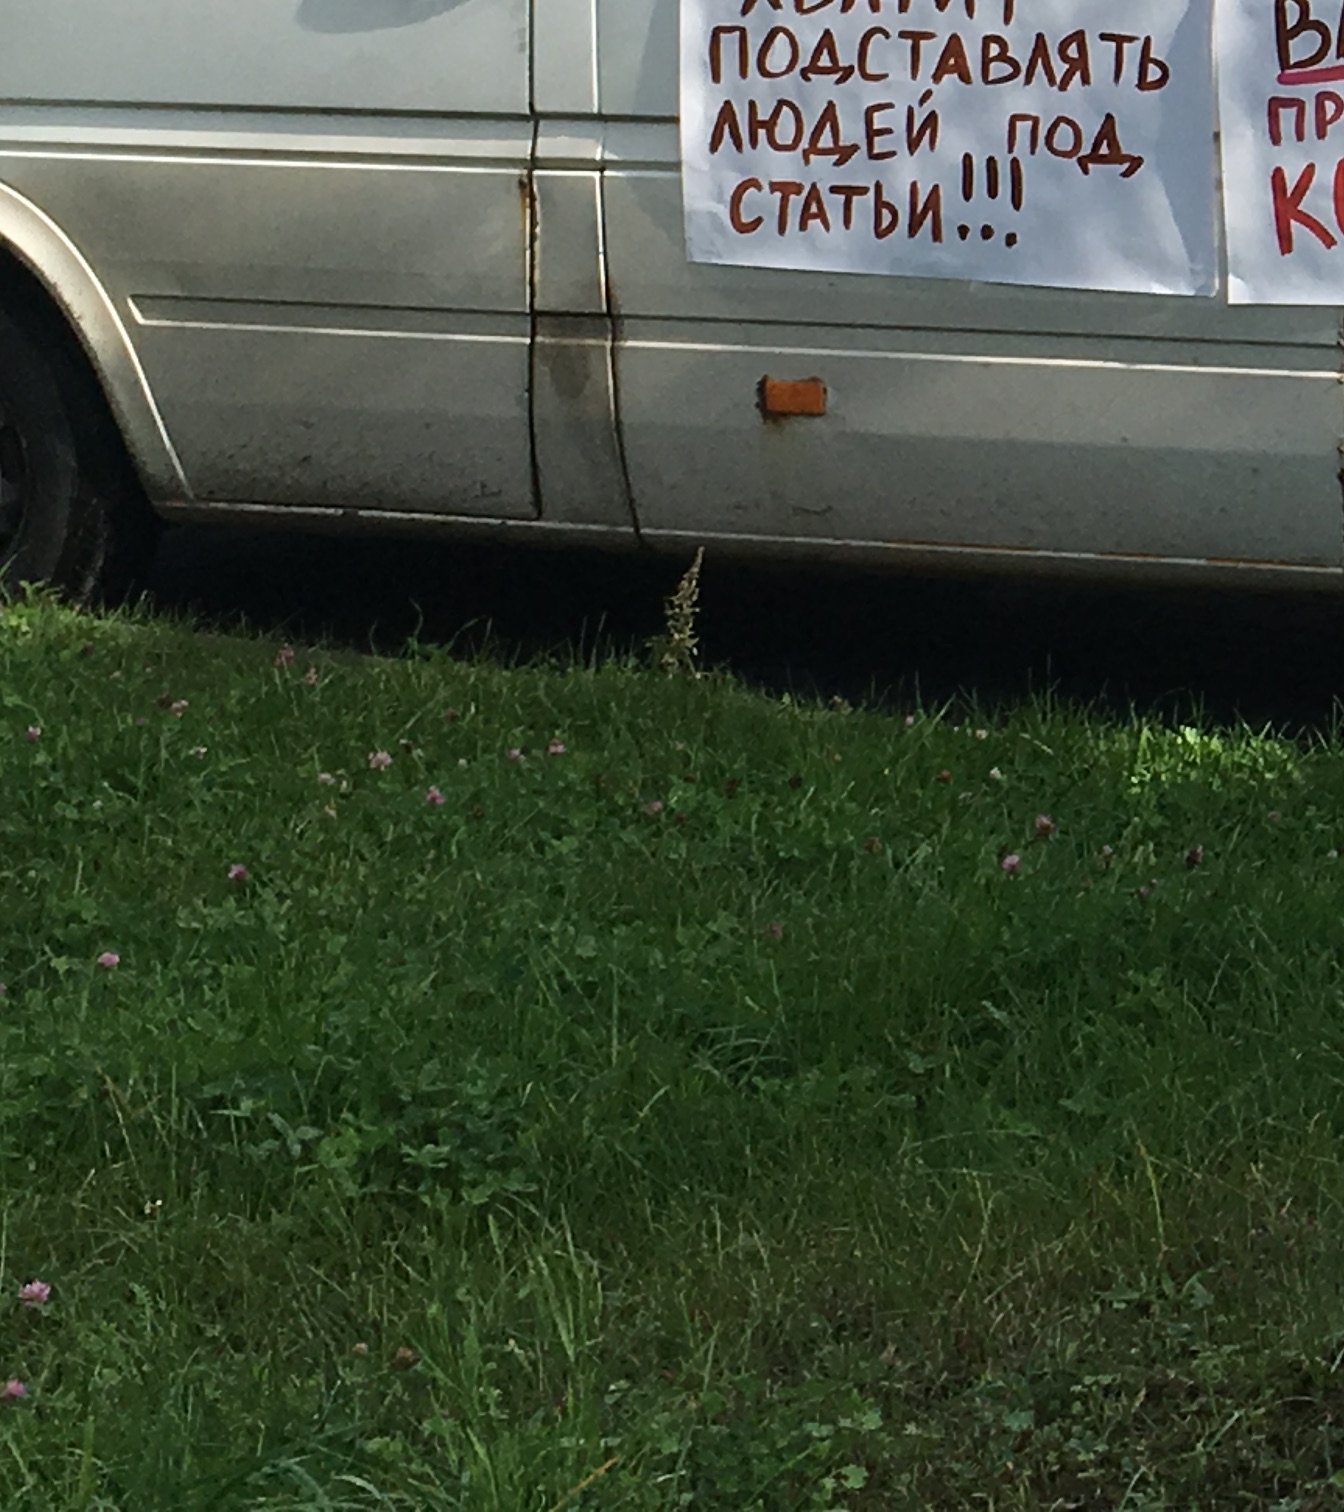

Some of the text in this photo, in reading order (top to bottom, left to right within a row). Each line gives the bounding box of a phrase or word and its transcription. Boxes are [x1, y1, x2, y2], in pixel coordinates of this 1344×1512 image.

[708, 25, 1170, 91] ПОДСТАВЛЯТЬ
[709, 90, 1145, 179] ЛЮДЕЙ ПОД
